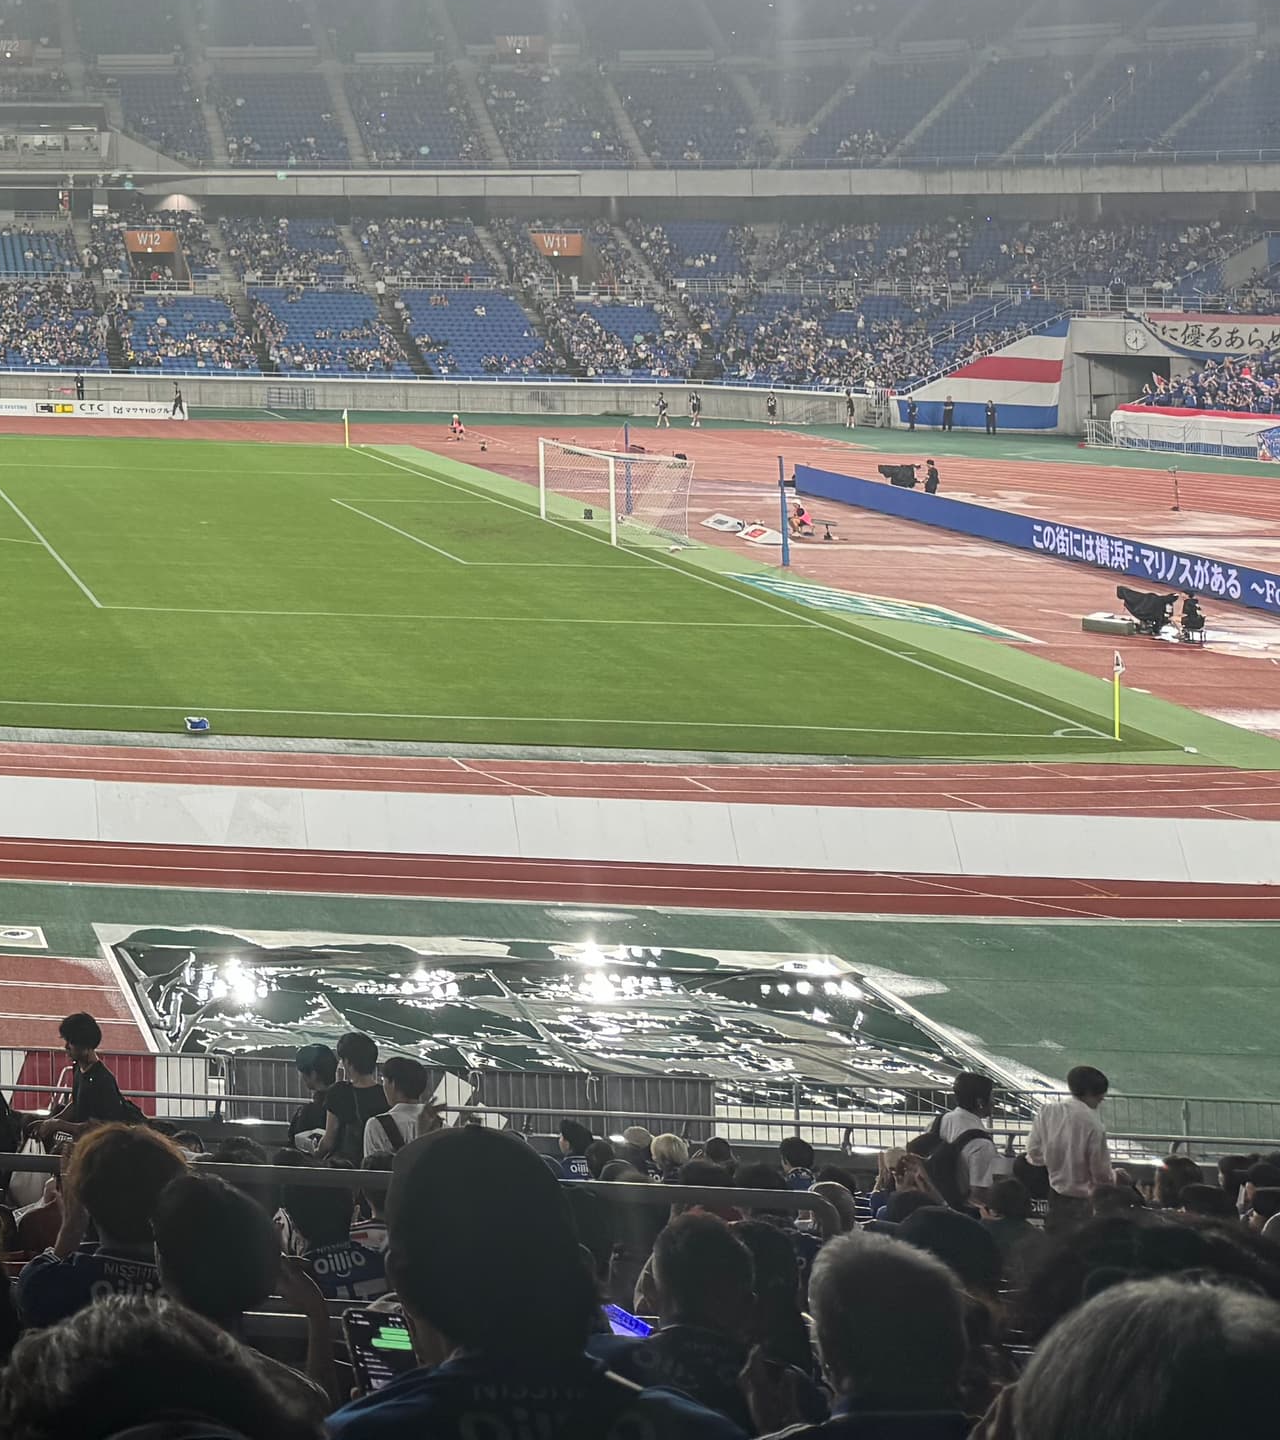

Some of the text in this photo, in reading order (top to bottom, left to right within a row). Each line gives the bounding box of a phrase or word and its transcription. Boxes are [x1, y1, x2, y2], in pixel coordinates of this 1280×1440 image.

[137, 232, 161, 245] W12
[543, 235, 568, 248] W11
[1148, 319, 1280, 349] に優るあらめ
[1032, 524, 1241, 599] この街には横浜F・マリノスがある
